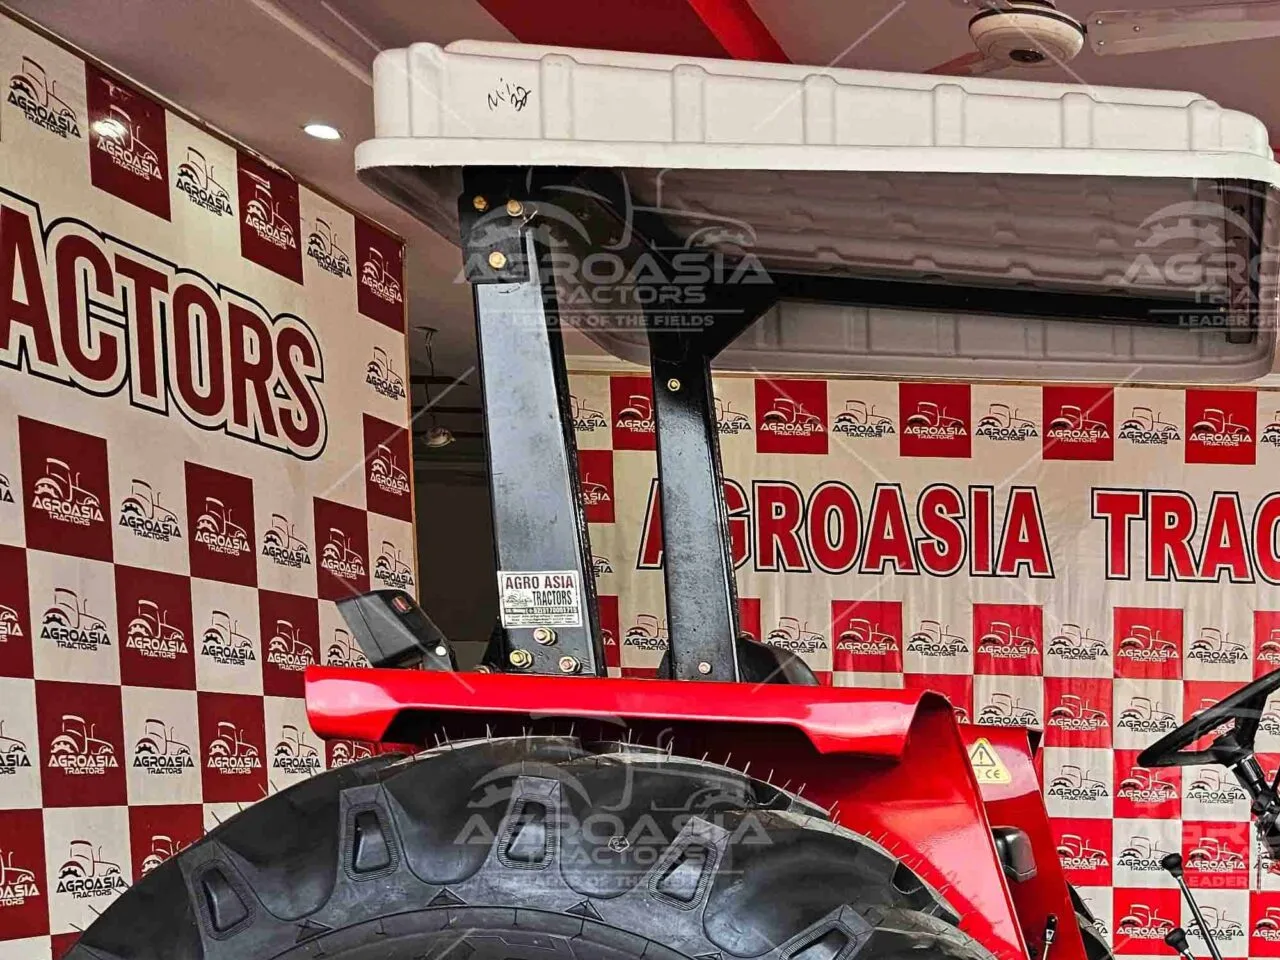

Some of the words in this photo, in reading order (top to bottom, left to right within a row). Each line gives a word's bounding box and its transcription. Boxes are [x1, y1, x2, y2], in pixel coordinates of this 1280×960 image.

[7, 90, 81, 139] AGROASIA
[96, 136, 162, 180] AGROASIA
[176, 178, 233, 216] AGROASIA
[245, 213, 296, 249] AGROASIA
[306, 248, 352, 277] AGROASIA
[361, 274, 402, 302] AGROASIA
[0, 190, 325, 460] ACTORS
[365, 374, 406, 398] AGROASIA
[760, 423, 824, 432] AGROASIA
[832, 425, 896, 434] AGROASIA
[904, 426, 967, 436] AGROASIA
[975, 428, 1038, 438] AGROASIA
[1046, 430, 1110, 439] AGROASIA
[1118, 431, 1181, 440] AGROASIA
[1189, 433, 1252, 443] AGROASIA
[370, 473, 410, 493] AGROASIA
[32, 496, 104, 522] AGROASIA
[119, 514, 182, 538] AGROASIA
[195, 531, 251, 552] AGROASIA
[262, 545, 311, 565] AGROASIA
[321, 558, 366, 576] AGROASIA
[374, 570, 414, 586] AGROASIA
[505, 576, 540, 590] AGRO
[544, 575, 574, 589] ASIA
[532, 590, 573, 606] TRACTORS
[40, 627, 111, 645] AGROASIA
[126, 636, 188, 654] AGROASIA
[836, 642, 899, 651] AGROASIA
[906, 643, 969, 653] AGROASIA
[977, 645, 1039, 655] AGROASIA
[201, 645, 256, 661] AGROASIA
[1047, 647, 1109, 656] AGROASIA
[1116, 649, 1179, 658] AGROASIA
[1187, 651, 1248, 660] AGROASIA
[1047, 718, 1109, 727] AGROASIA
[1116, 720, 1178, 729] AGROASIA
[48, 755, 118, 767] AGROASIA
[133, 756, 194, 767] AGROASIA
[207, 756, 262, 768] AGROASIA
[273, 757, 321, 768] AGROASIA
[1048, 788, 1109, 797] AGROASIA
[1116, 790, 1178, 799] AGROASIA
[1185, 791, 1246, 800] AGROASIA
[1185, 860, 1246, 869] AGROASIA
[56, 876, 126, 894] AGROASIA
